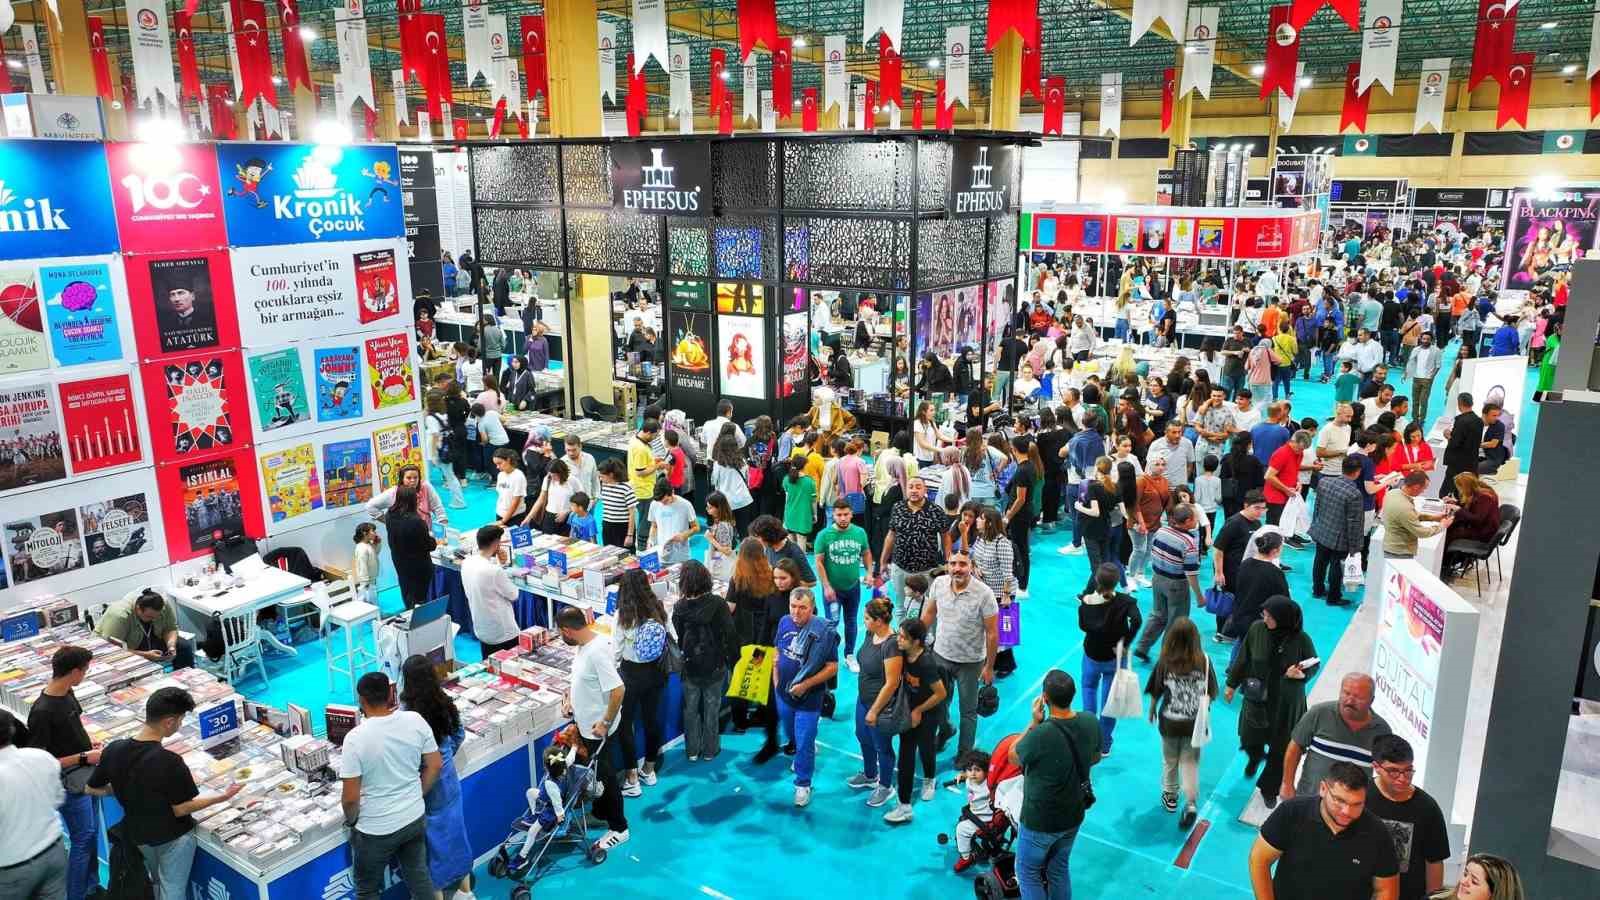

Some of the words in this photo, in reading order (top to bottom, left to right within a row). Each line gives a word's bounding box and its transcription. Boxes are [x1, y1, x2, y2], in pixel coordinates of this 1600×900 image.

[273, 191, 365, 219] Kronik
[623, 189, 699, 211] EPHESUS
[956, 191, 1004, 213] EPHESUS
[1521, 207, 1598, 219] BLACKPINK
[308, 216, 366, 240] Çocuk
[250, 259, 340, 278] Cumhuriyet’in
[266, 278, 290, 292] 100.
[293, 275, 334, 292] yılında
[254, 293, 314, 311] çocuklara
[316, 289, 344, 305] eşsiz
[260, 311, 280, 325] bir
[282, 306, 345, 324] armağan...
[166, 332, 215, 346] ATATÜRK
[12, 389, 46, 402] JENKINS
[12, 400, 49, 414] AVRUPA
[213, 714, 229, 728] 30
